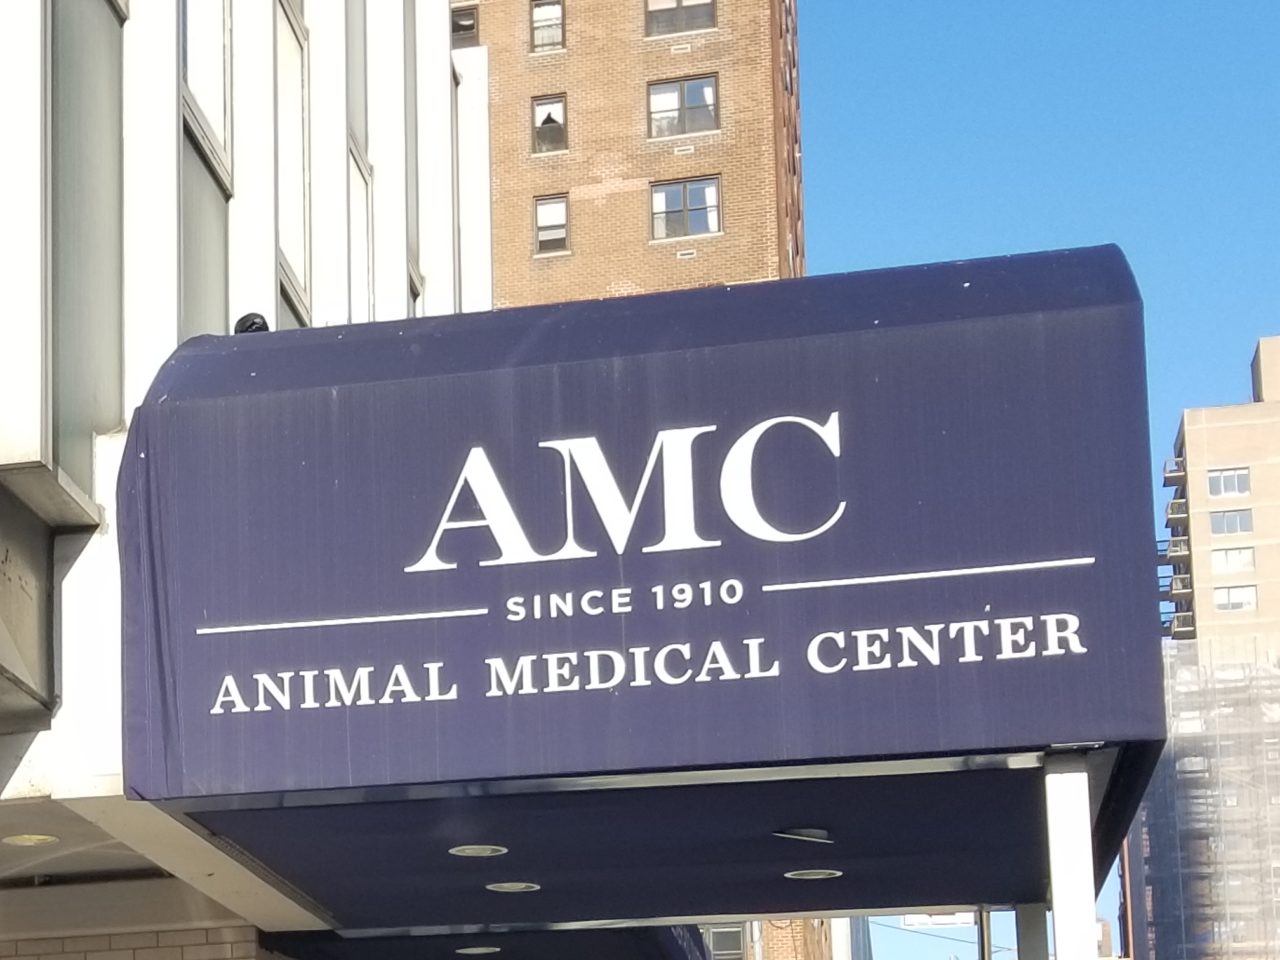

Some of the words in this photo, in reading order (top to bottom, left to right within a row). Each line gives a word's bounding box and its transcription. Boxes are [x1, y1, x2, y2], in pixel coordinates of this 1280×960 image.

[403, 412, 848, 574] AMC
[505, 587, 633, 622] SINCE
[651, 578, 744, 611] 1910
[209, 661, 458, 715] ANIMAL
[484, 637, 780, 698] MEDICAL
[807, 613, 1088, 675] CENTER
